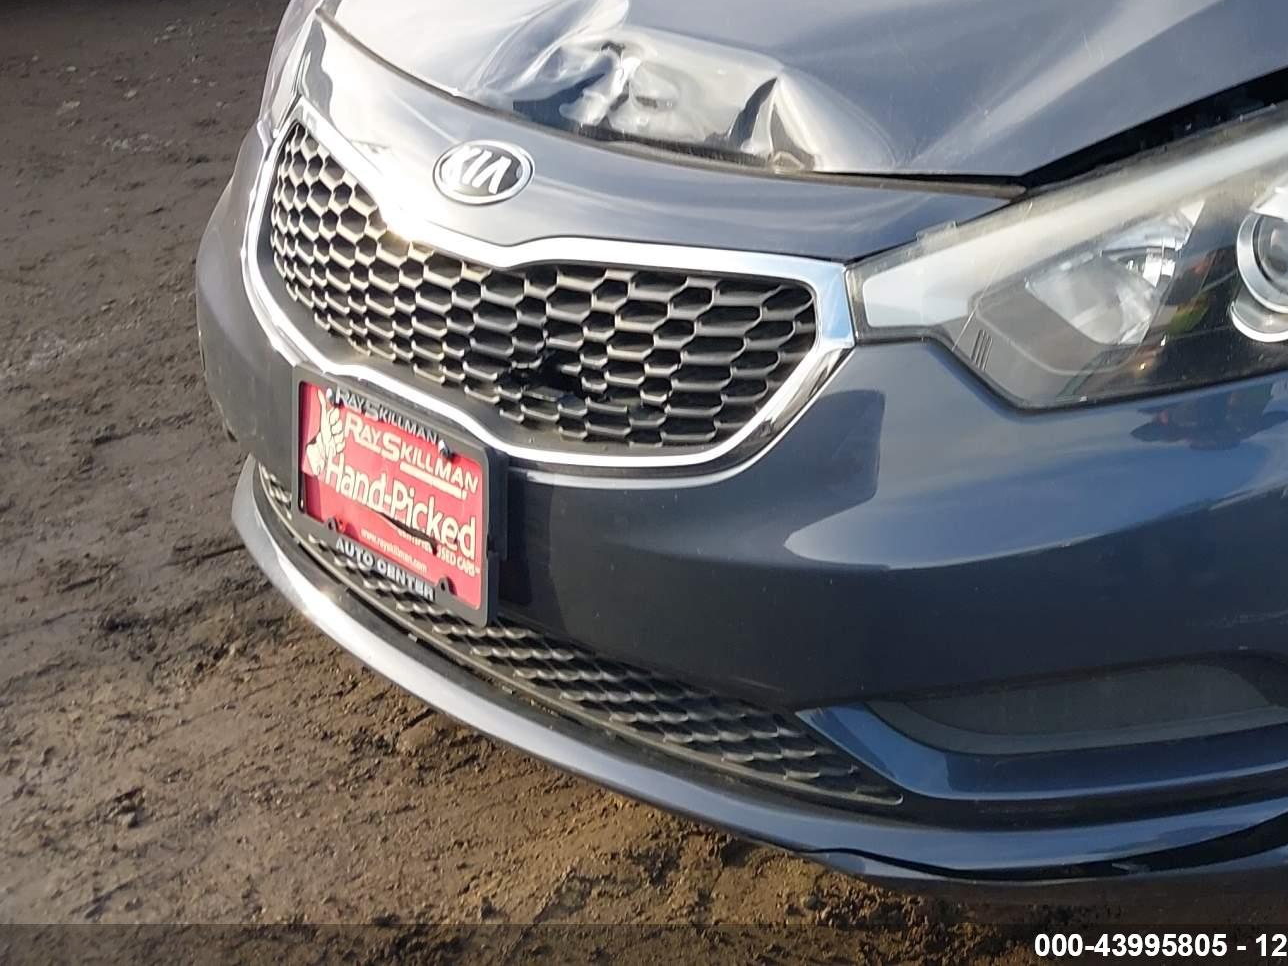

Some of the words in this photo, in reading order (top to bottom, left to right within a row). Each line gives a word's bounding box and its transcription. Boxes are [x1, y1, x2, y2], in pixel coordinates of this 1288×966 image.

[343, 412, 381, 450] RAY
[381, 431, 479, 494] SKILLMAN
[325, 450, 477, 560] Hand-Picked
[335, 537, 374, 567] AUTO
